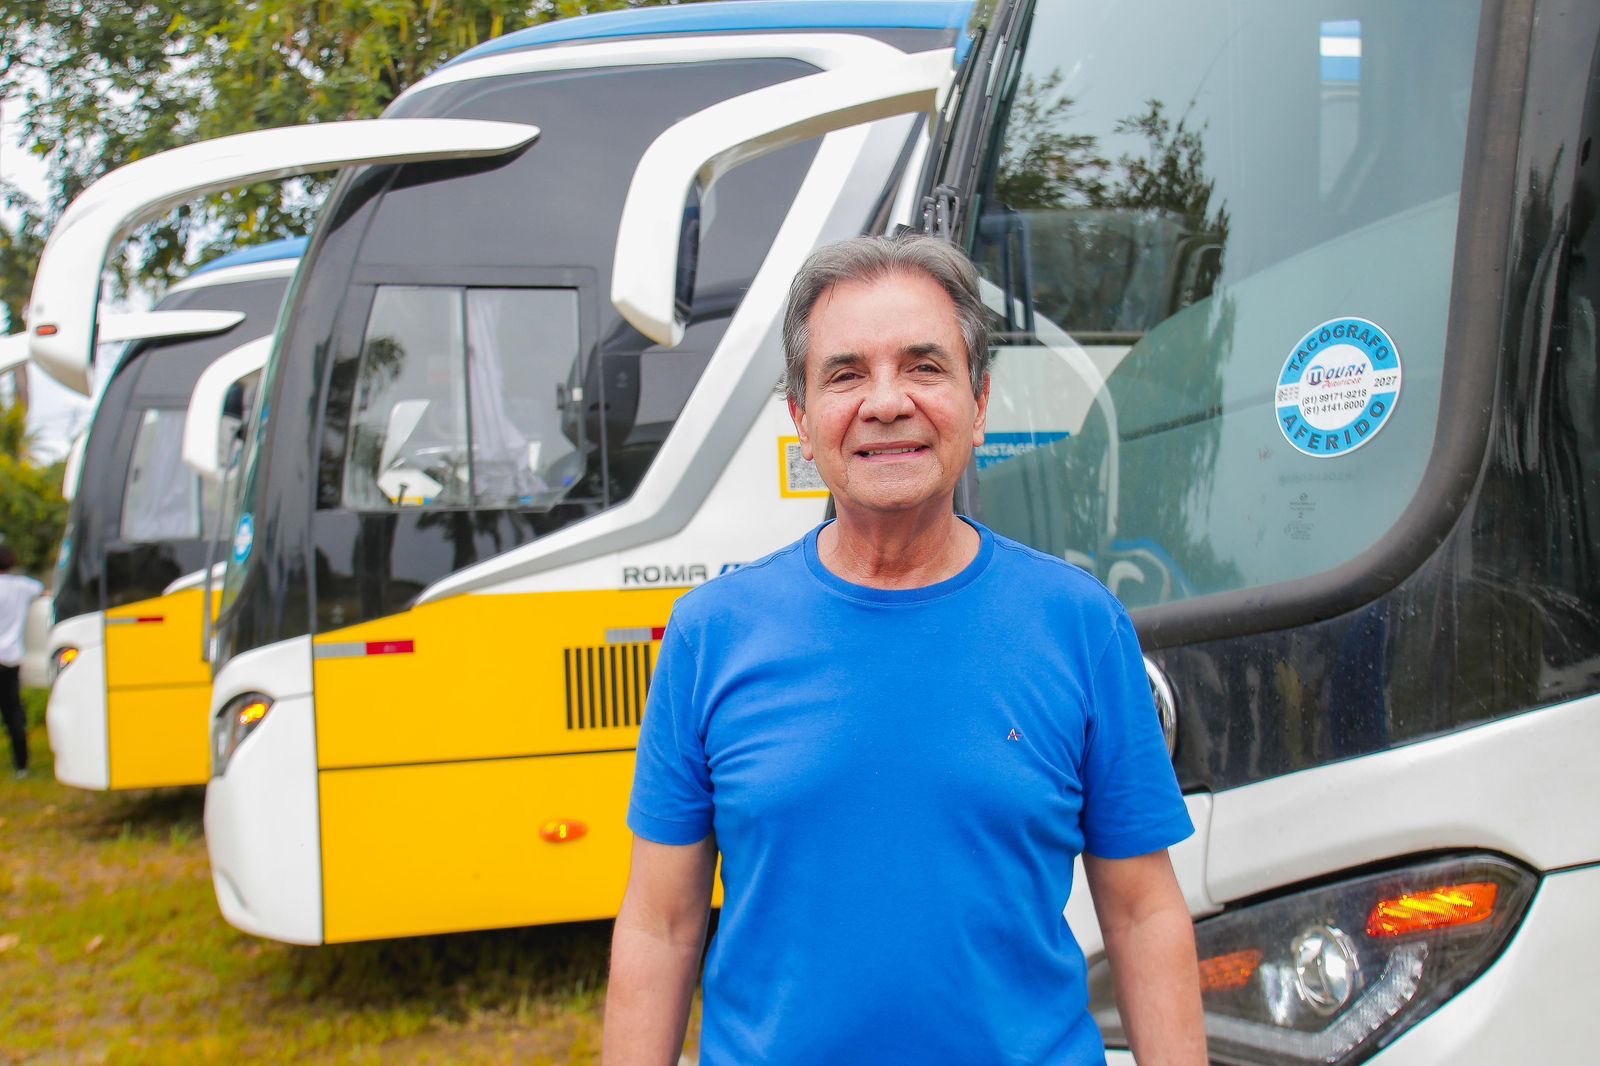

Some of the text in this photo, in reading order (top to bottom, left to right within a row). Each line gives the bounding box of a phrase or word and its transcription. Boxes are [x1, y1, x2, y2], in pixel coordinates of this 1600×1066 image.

[1288, 324, 1389, 373] TACÓGRAFO
[1373, 375, 1398, 388] 2027
[1302, 388, 1367, 408] (81) 99171-9218
[1304, 406, 1320, 418] (81)
[1283, 400, 1386, 451] AFERIDO
[623, 564, 707, 584] ROMA
